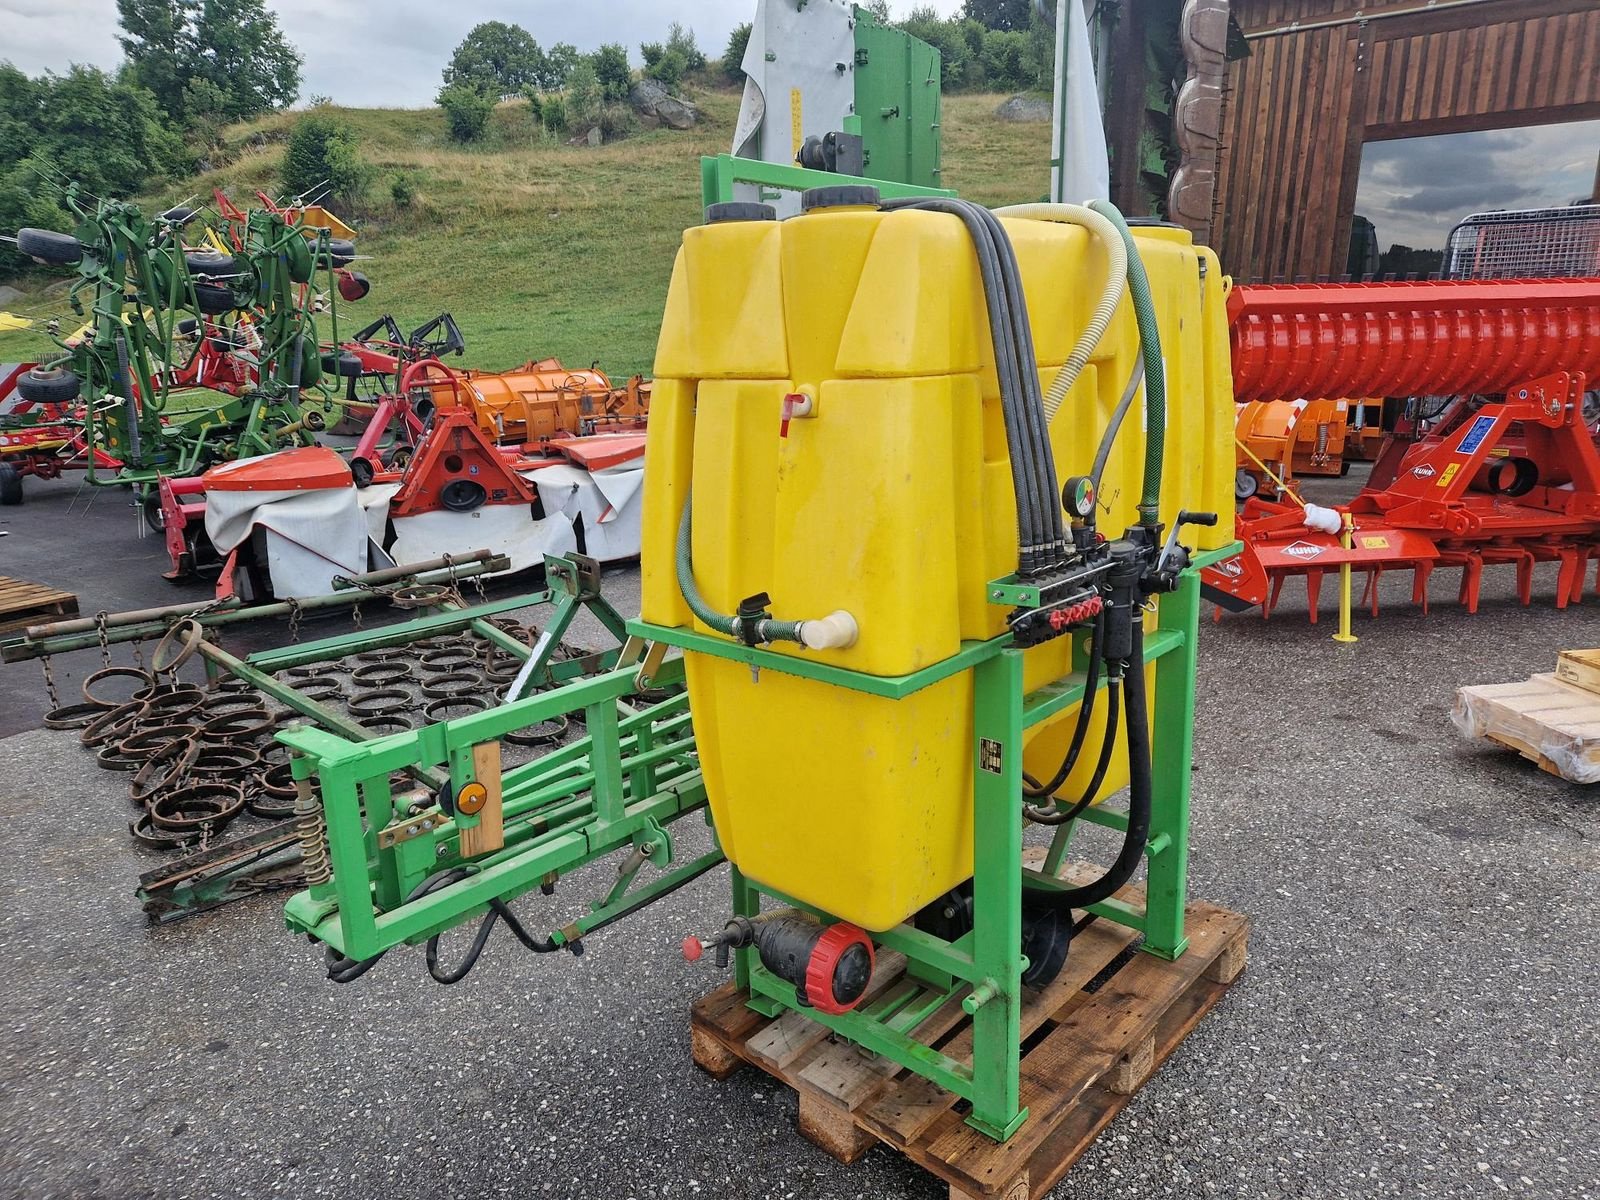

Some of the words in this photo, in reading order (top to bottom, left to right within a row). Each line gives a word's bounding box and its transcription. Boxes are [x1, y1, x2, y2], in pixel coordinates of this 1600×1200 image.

[1414, 467, 1433, 476] KUHN
[1288, 546, 1320, 555] KUHN
[1226, 564, 1240, 574] KUHN
